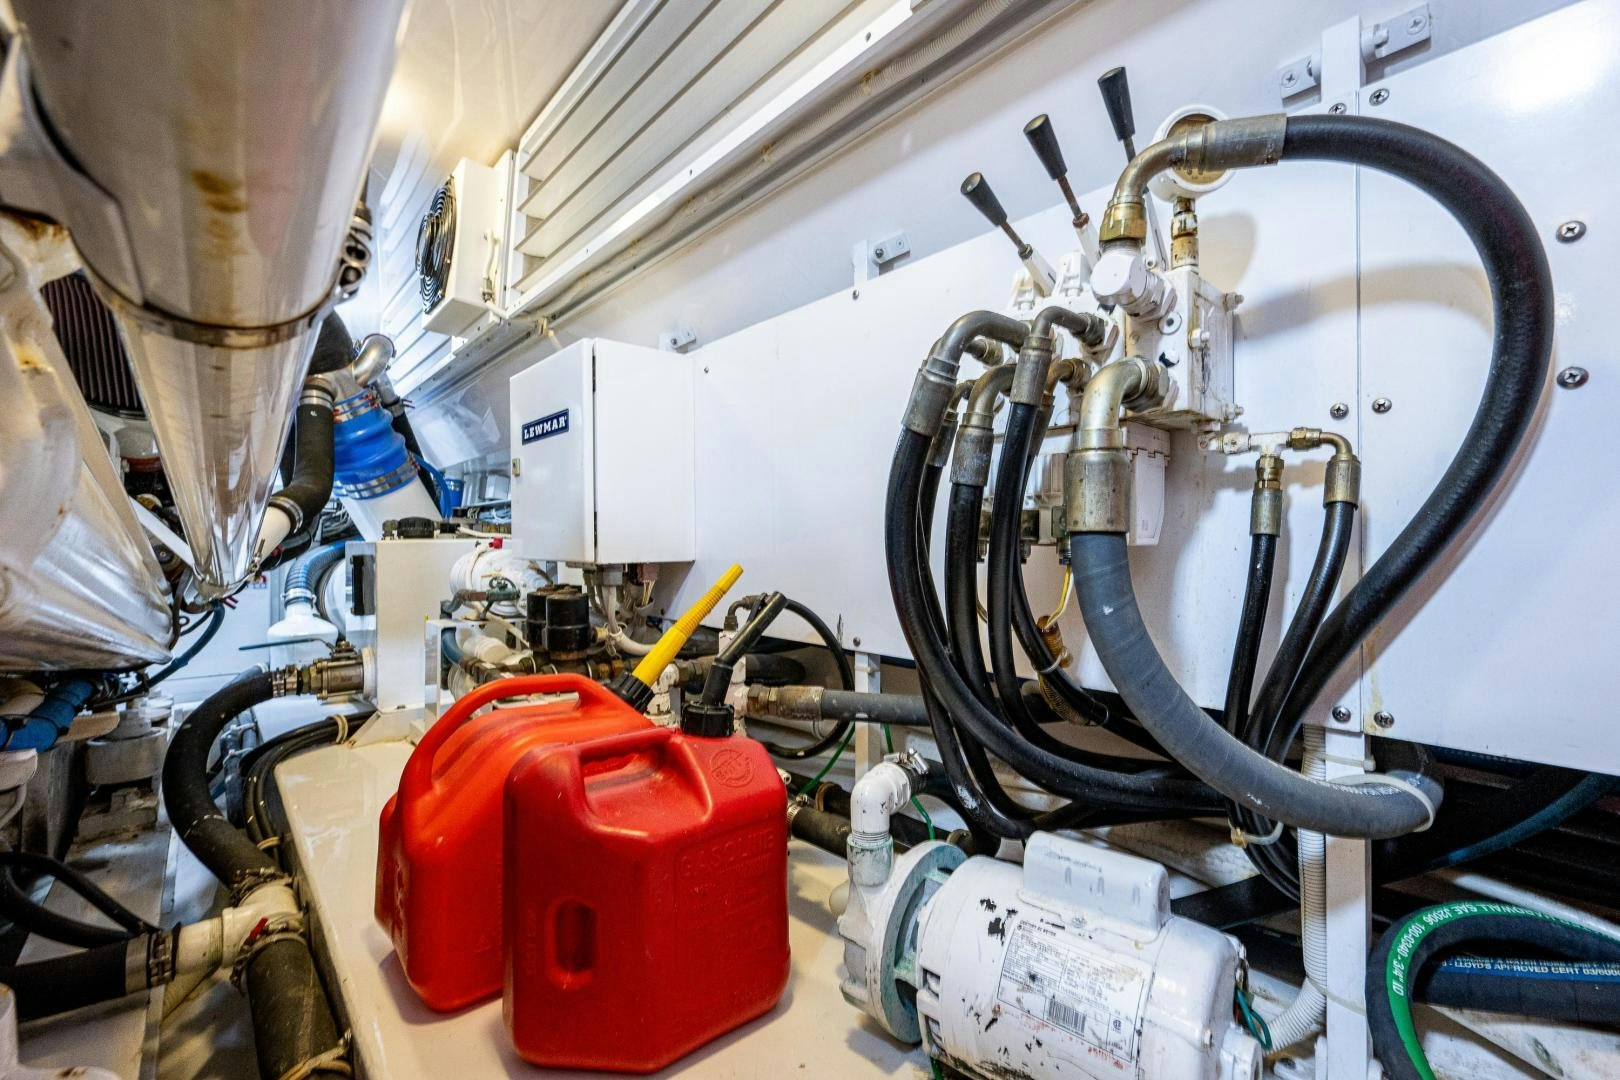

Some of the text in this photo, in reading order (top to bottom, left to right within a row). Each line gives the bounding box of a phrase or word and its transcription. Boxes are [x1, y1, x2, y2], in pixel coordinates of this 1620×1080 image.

[524, 416, 565, 439] LEWMAR
[1423, 908, 1452, 925] J2006
[1451, 903, 1478, 915] SAE
[1455, 960, 1492, 970] LLOYD'S
[1494, 962, 1549, 973] APPROVED
[1551, 966, 1581, 975] CERT
[1392, 980, 1404, 996] ID
